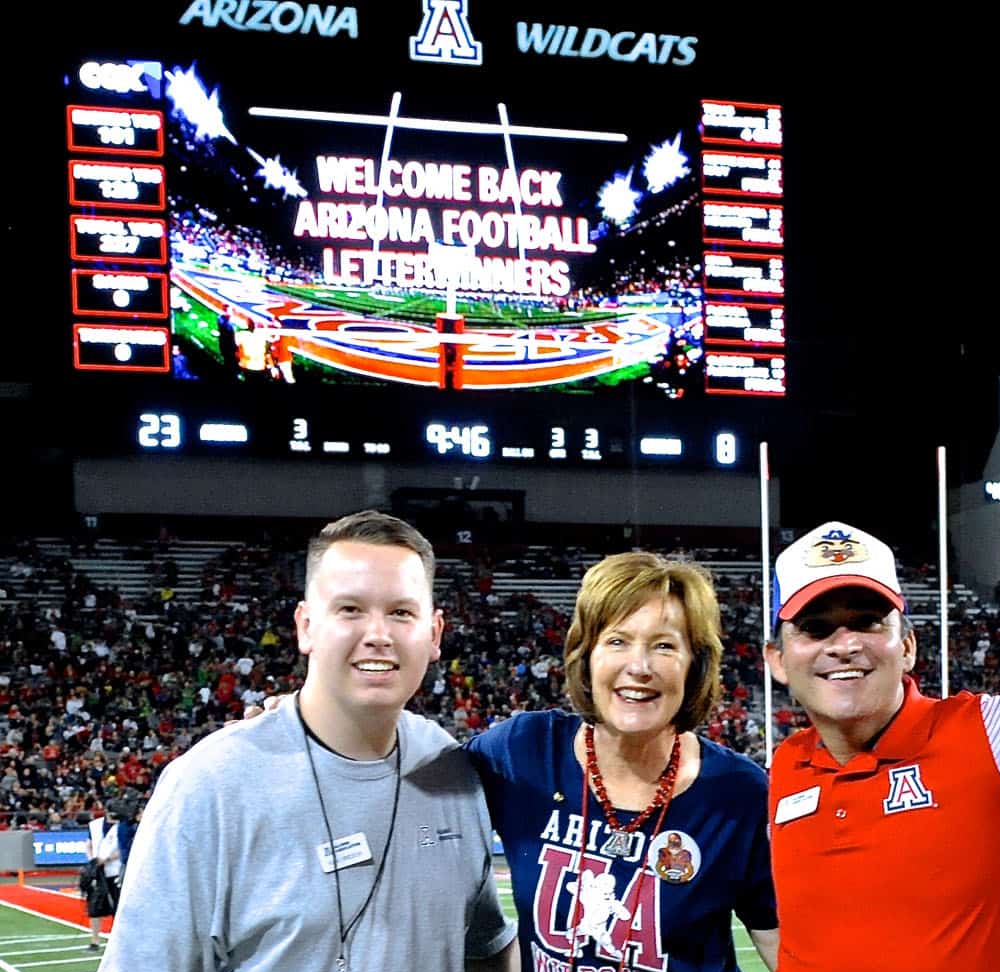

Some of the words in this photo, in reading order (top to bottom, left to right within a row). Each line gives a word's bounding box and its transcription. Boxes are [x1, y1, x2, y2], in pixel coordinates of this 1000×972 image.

[178, 0, 359, 38] ARIZONA
[410, 0, 483, 66] A
[516, 21, 698, 66] WILDCATS
[316, 156, 472, 201] WELCOME
[478, 166, 563, 207] BACK
[294, 200, 436, 244] ARIZONA
[442, 209, 597, 254] FOOTBALL
[138, 413, 181, 447] 23
[293, 418, 307, 439] 3
[425, 424, 490, 457] 9:46
[552, 427, 565, 448] 3
[585, 428, 599, 448] 3
[456, 530, 472, 544] 12
[883, 765, 933, 815] A
